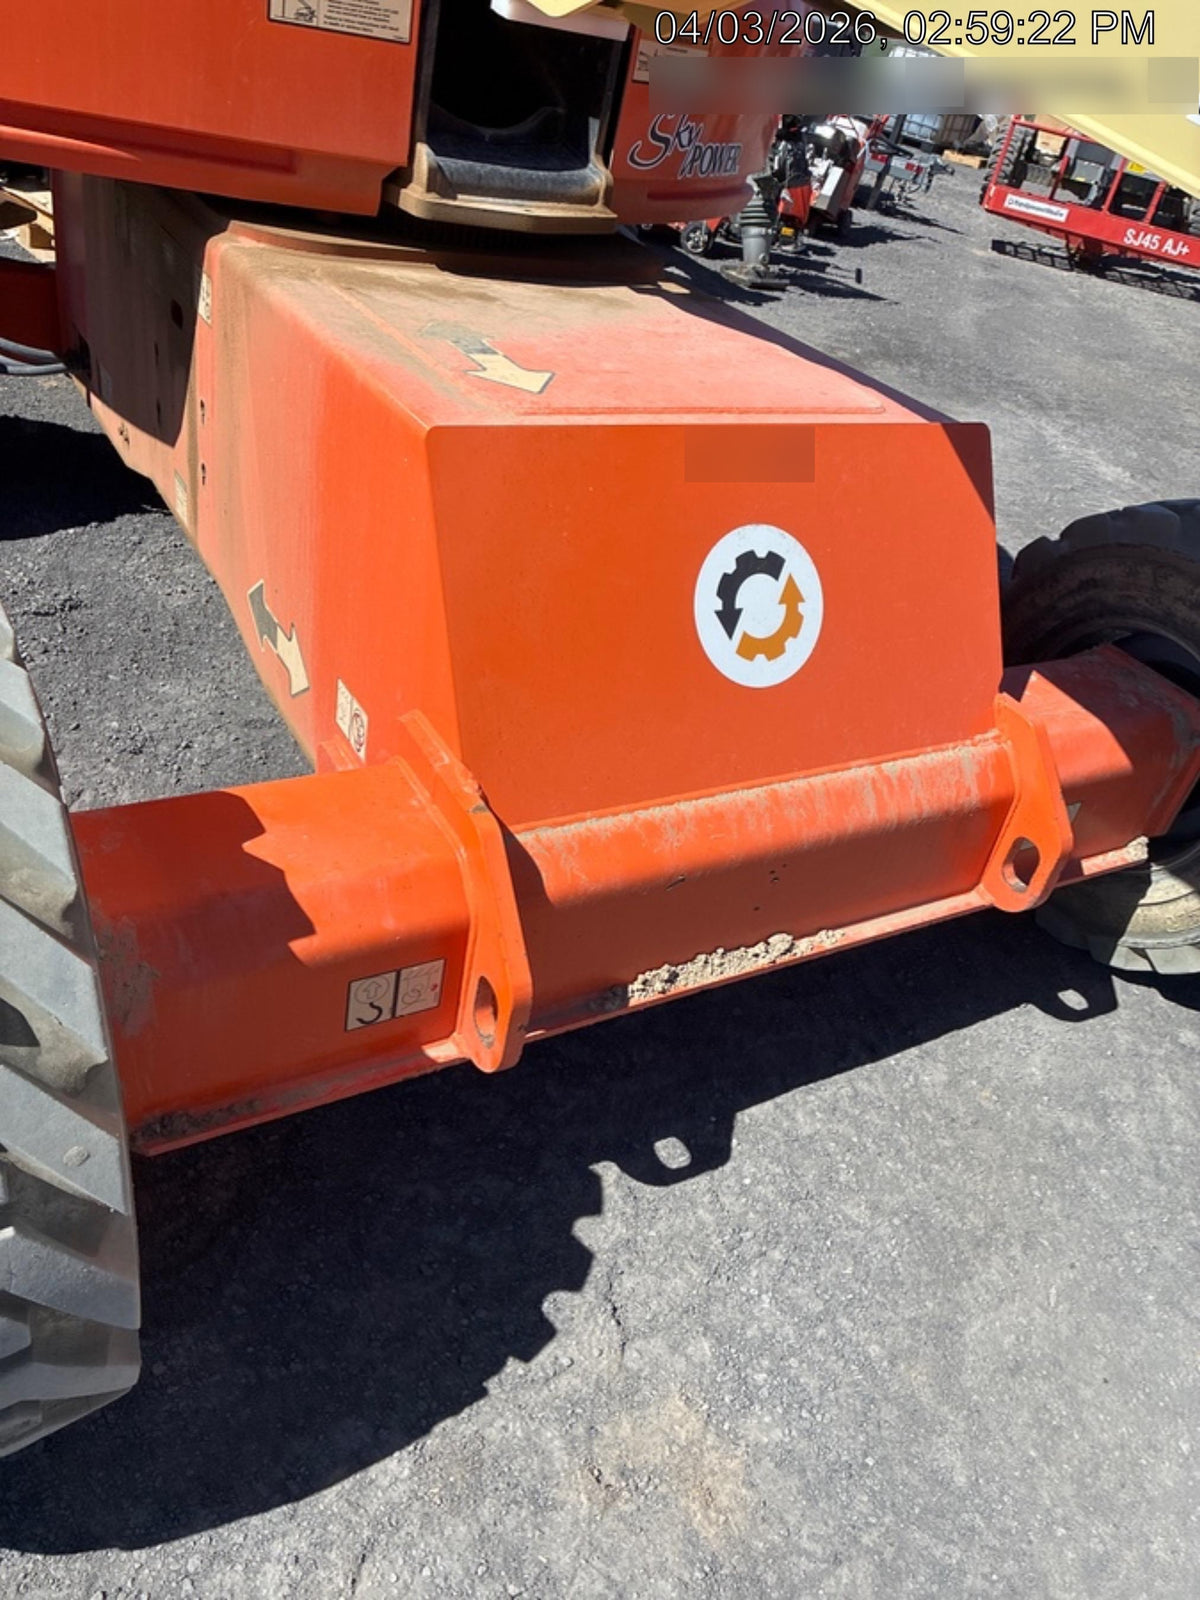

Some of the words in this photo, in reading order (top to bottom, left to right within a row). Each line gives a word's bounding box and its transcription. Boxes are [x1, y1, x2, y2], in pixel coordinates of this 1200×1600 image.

[627, 114, 704, 178] Sky
[686, 142, 743, 178] POWER
[1123, 228, 1161, 252] SJ45
[1161, 240, 1190, 257] AJ+
